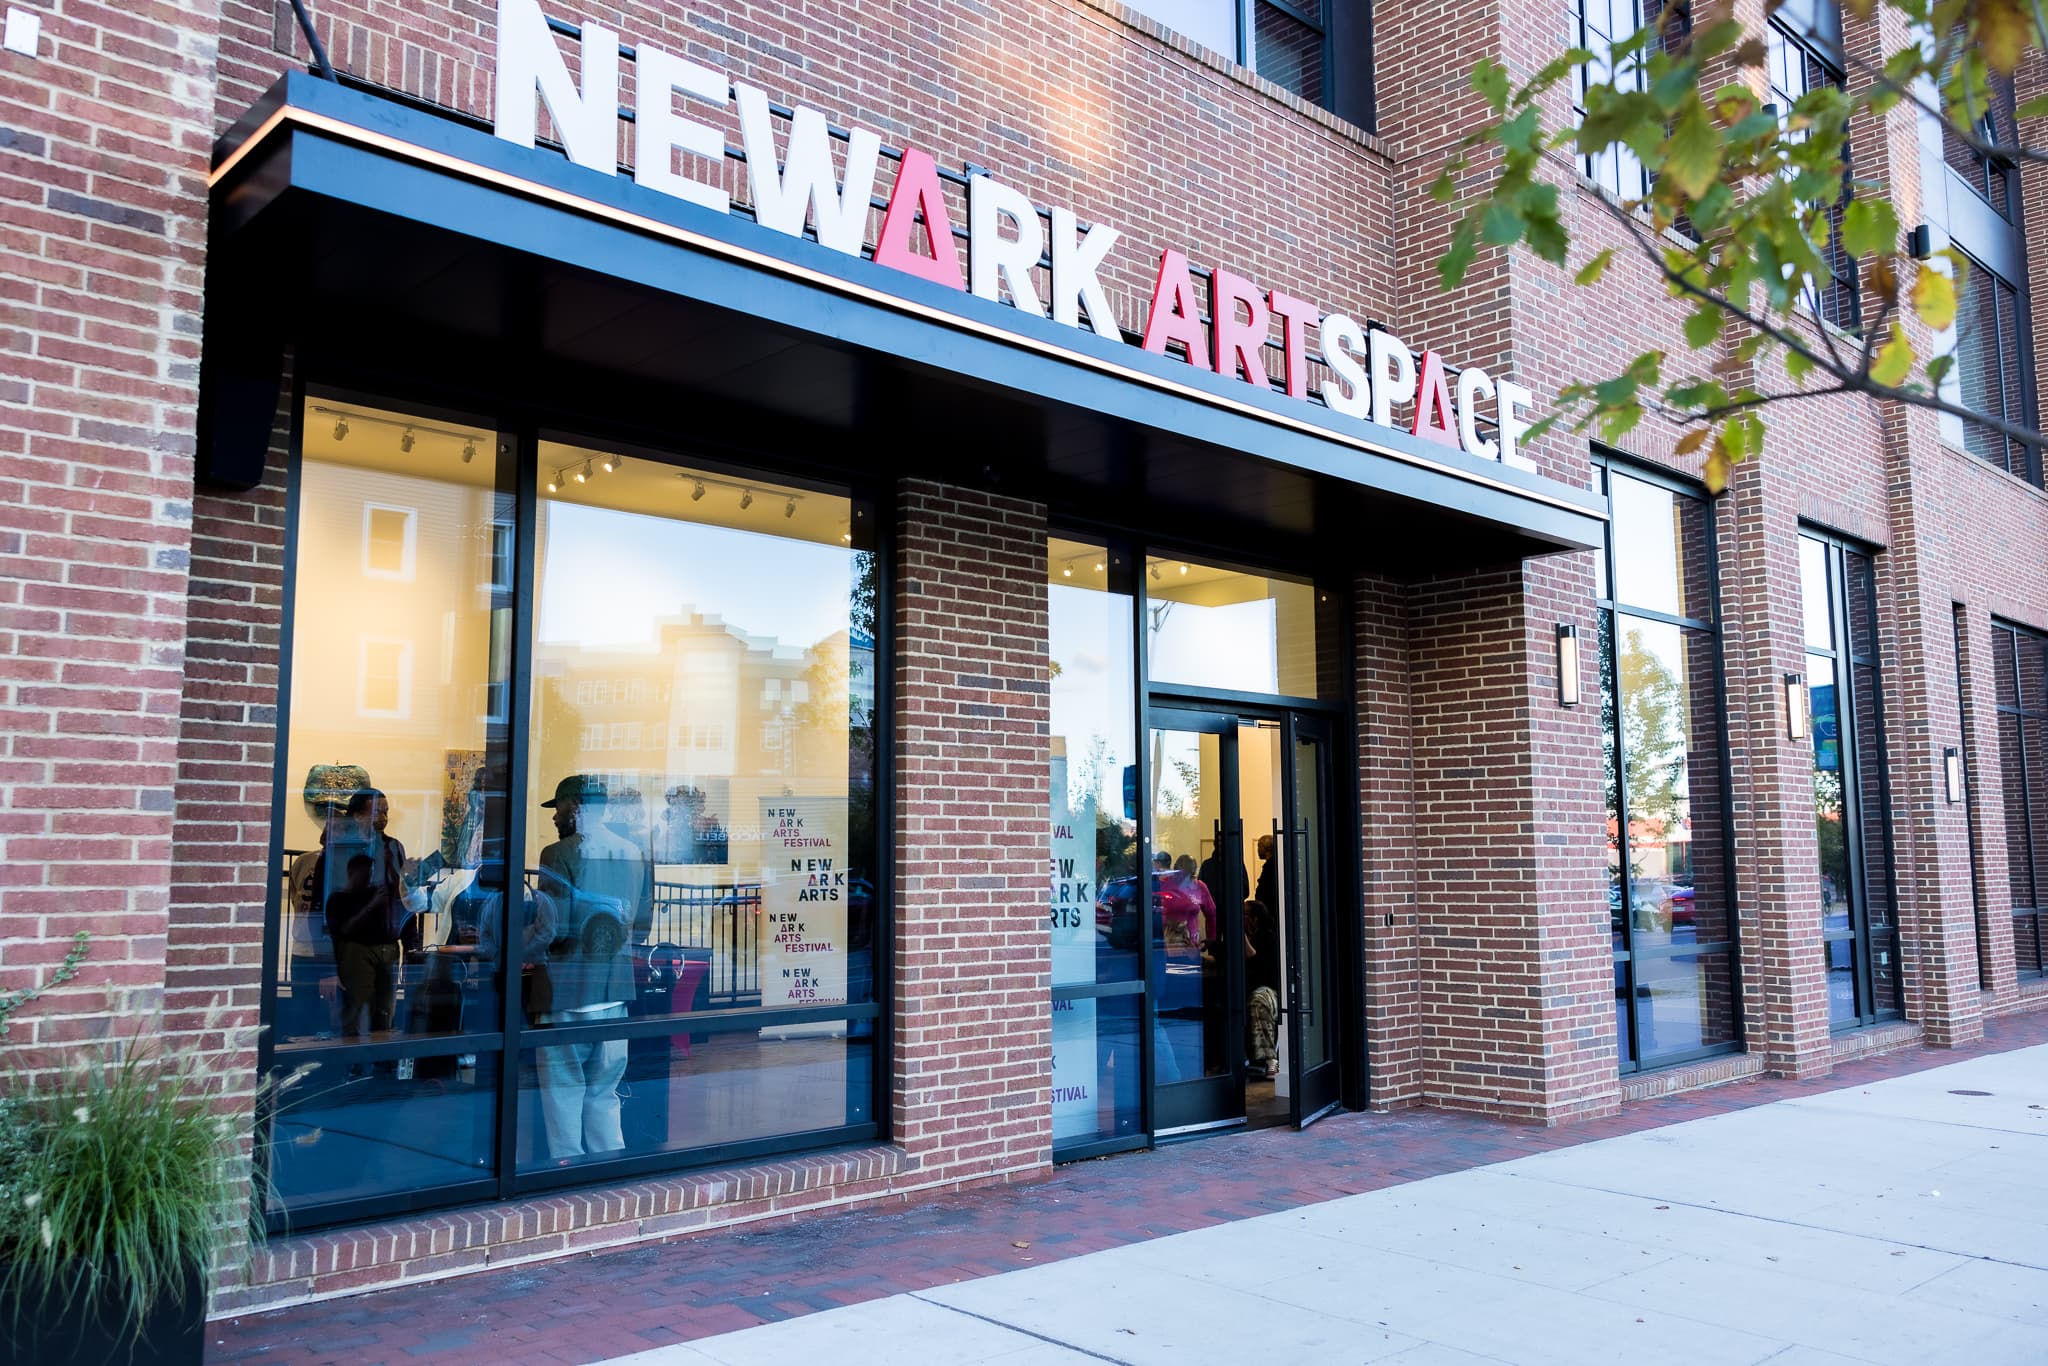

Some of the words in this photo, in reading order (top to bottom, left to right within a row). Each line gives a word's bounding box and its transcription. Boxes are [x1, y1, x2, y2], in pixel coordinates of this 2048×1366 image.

[493, 0, 1123, 344] NEWARK
[773, 828, 800, 838] ARTS
[784, 838, 832, 848] FESTIVAL
[798, 888, 839, 902] ARTS
[774, 933, 802, 943] ARTS
[785, 942, 834, 952] FESTIVAL
[787, 989, 815, 999] ARTS
